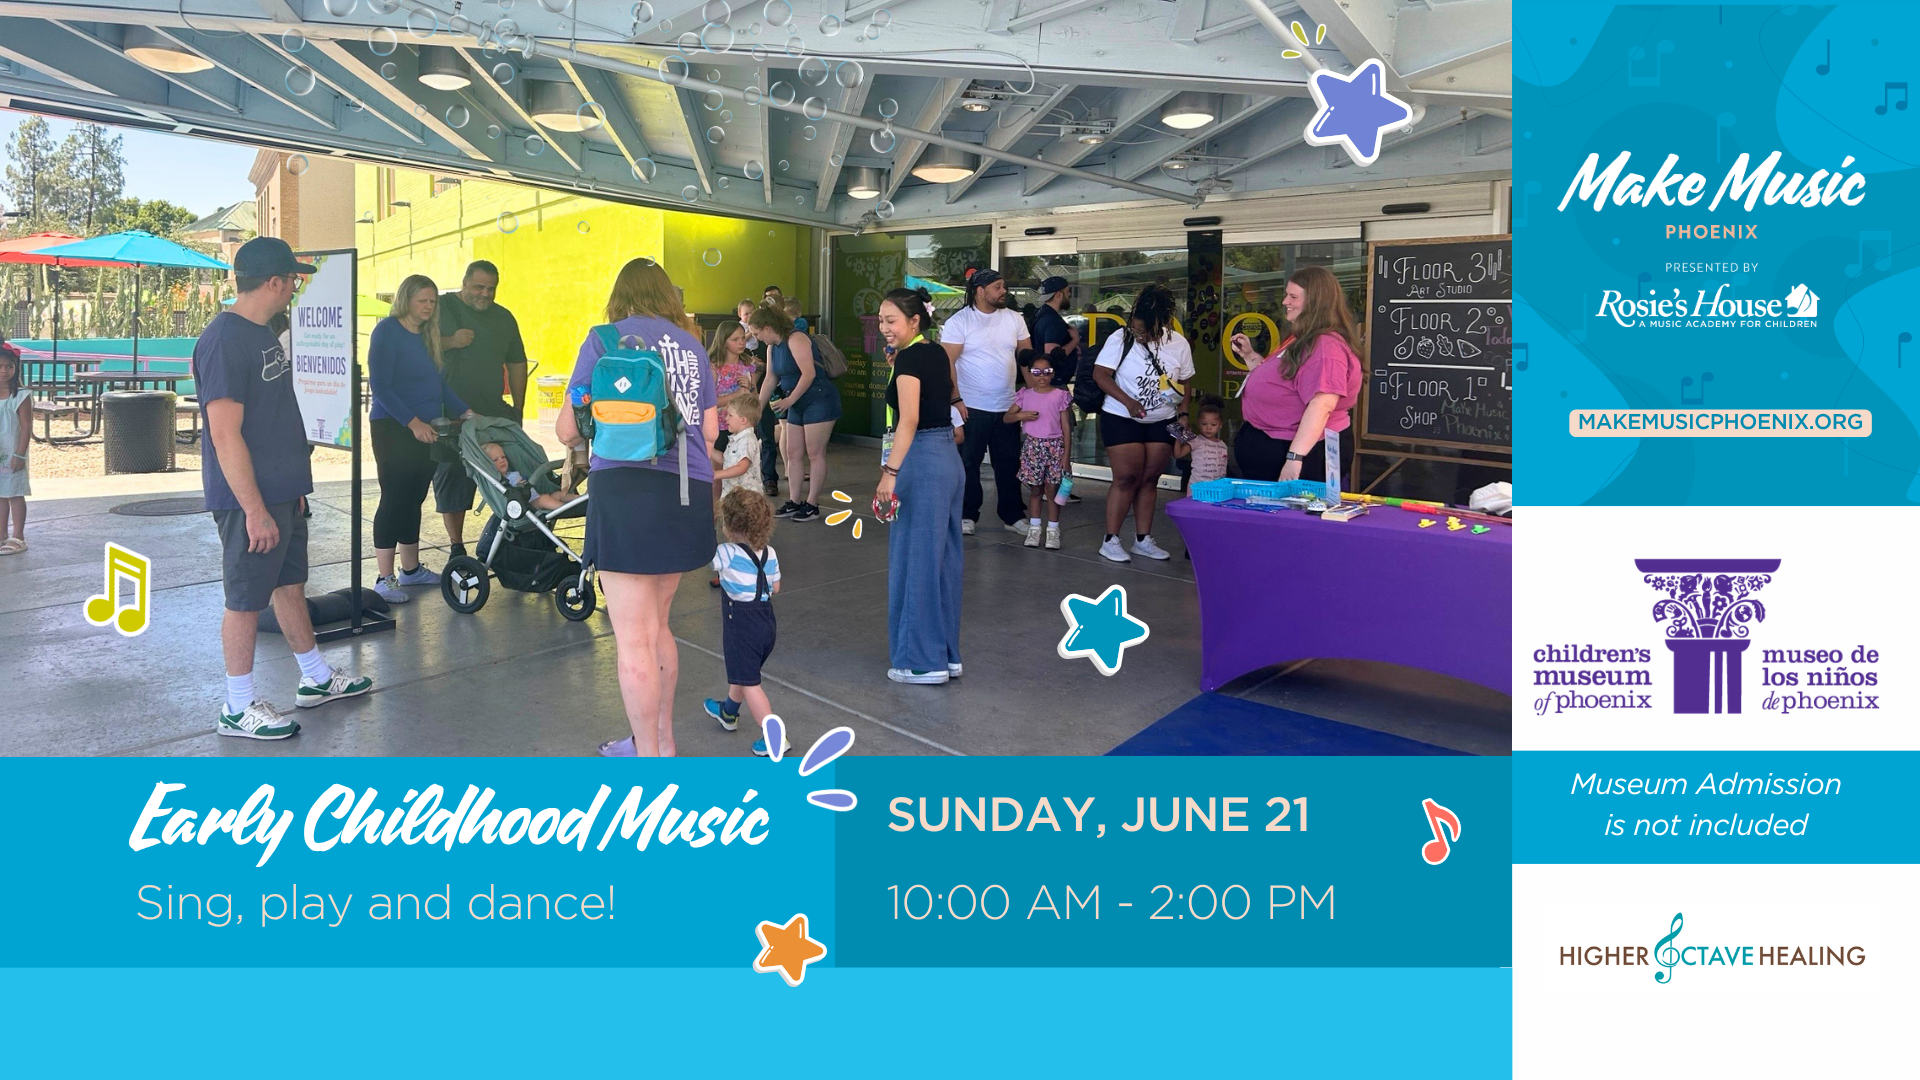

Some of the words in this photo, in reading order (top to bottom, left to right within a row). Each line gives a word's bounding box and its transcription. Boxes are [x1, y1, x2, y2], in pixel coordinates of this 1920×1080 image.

[1393, 256, 1463, 285] FLOOR
[1468, 252, 1487, 283] 3
[298, 306, 343, 328] WELCOME
[1390, 307, 1460, 335] FLOOR
[1465, 307, 1487, 334] 2
[296, 354, 347, 376] BIENVENIDOS
[1388, 371, 1459, 402] FLOOR
[1463, 376, 1478, 401] 1
[1441, 399, 1473, 416] Make
[1475, 401, 1509, 420] Music
